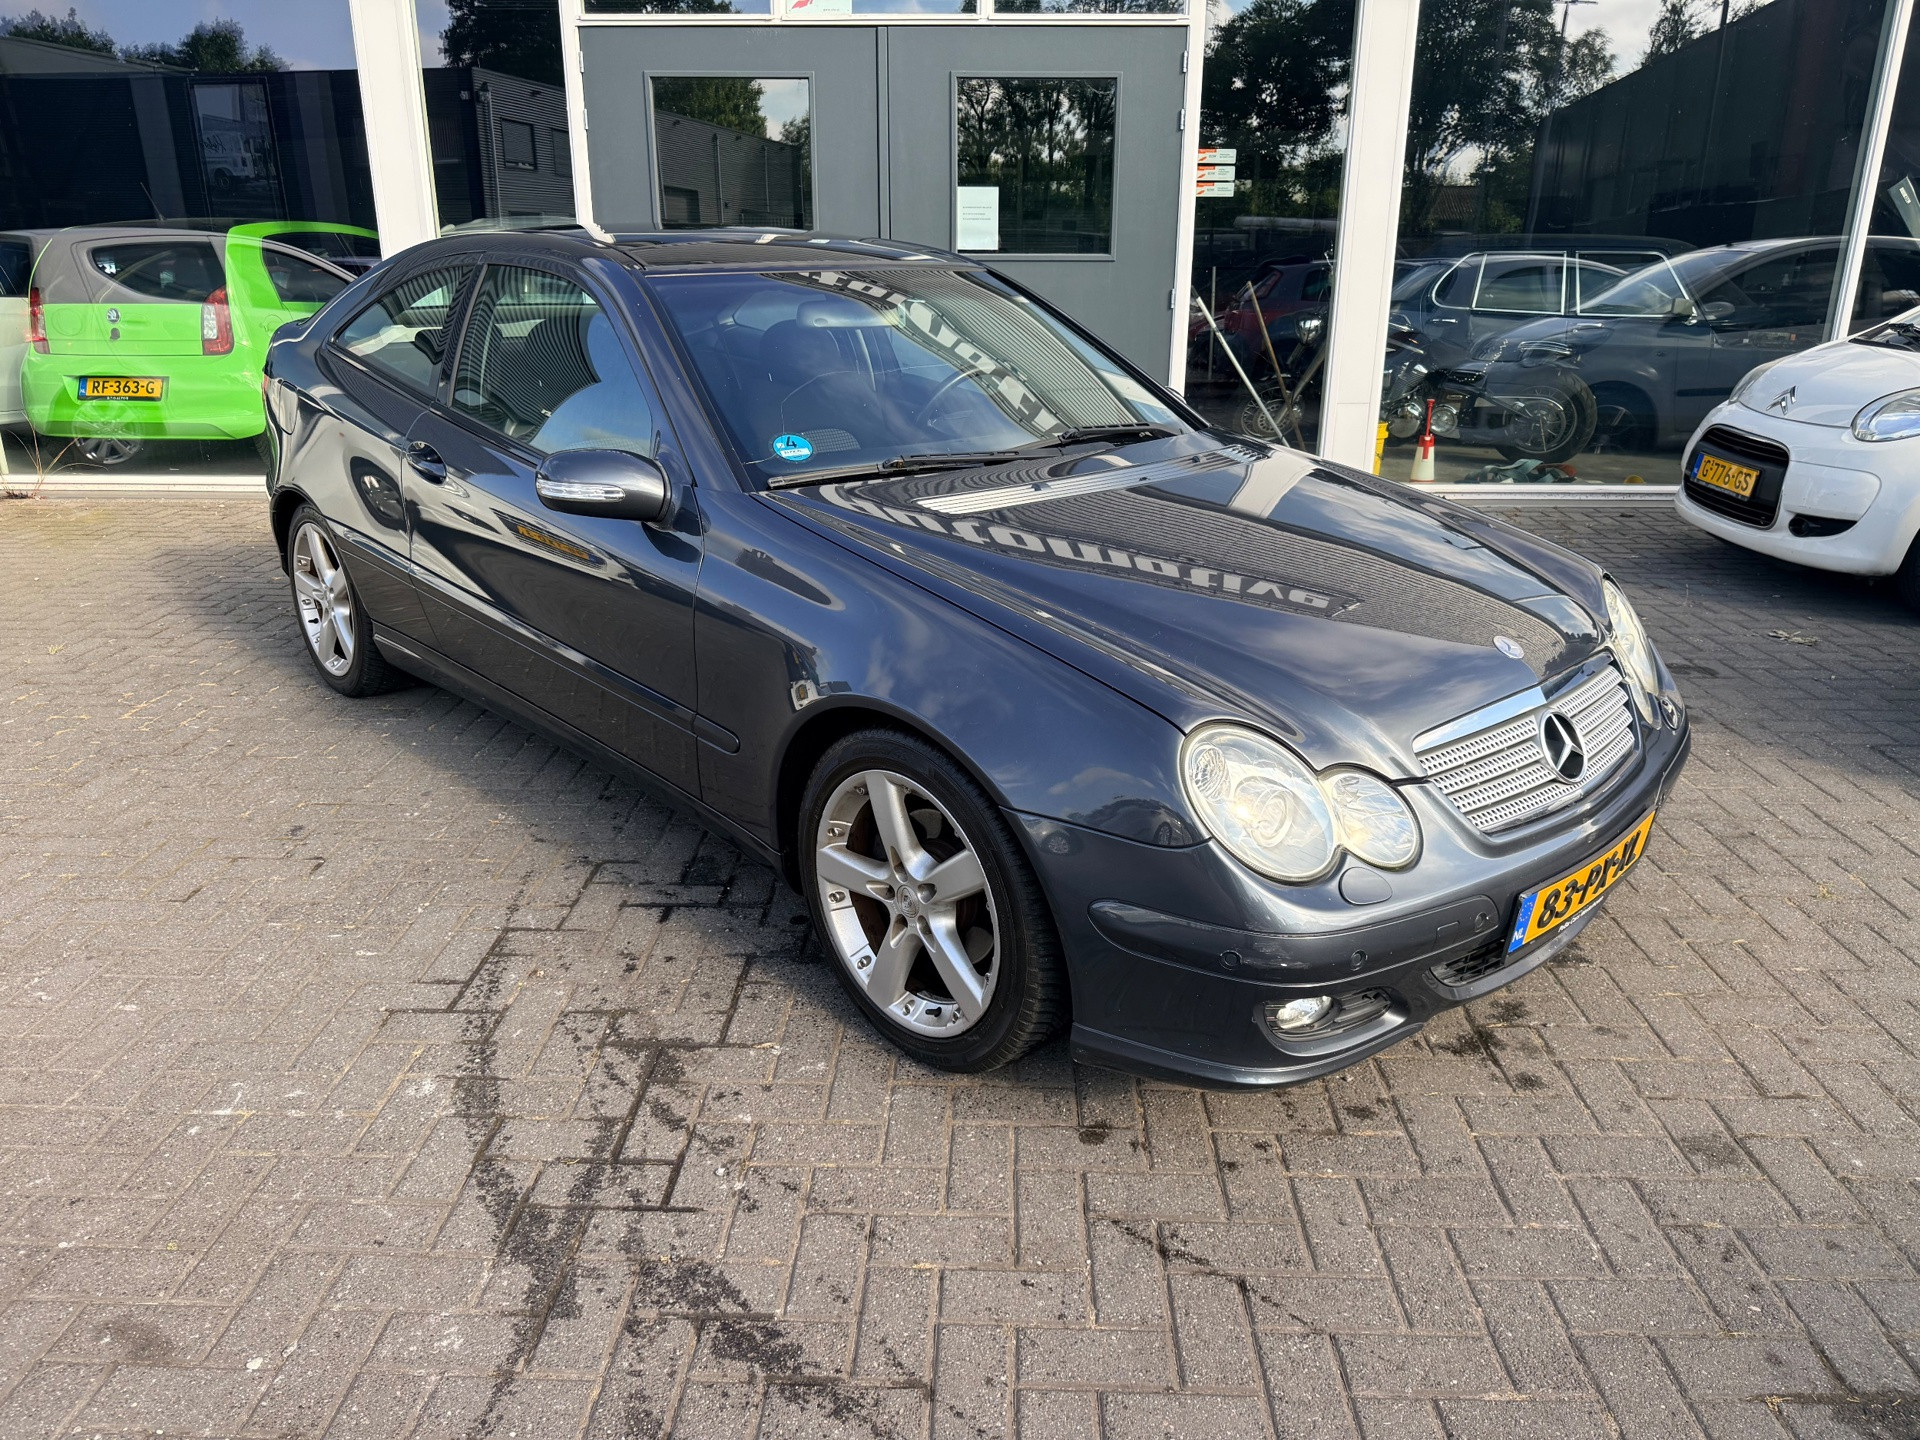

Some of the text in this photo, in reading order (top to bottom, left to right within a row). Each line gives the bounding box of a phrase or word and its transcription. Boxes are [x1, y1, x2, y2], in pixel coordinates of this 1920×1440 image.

[91, 380, 155, 395] RF-363-G
[786, 436, 798, 448] 4
[1702, 459, 1752, 492] G-776-GS
[1537, 829, 1642, 929] 83-PX-XL
[1511, 927, 1525, 943] NL
